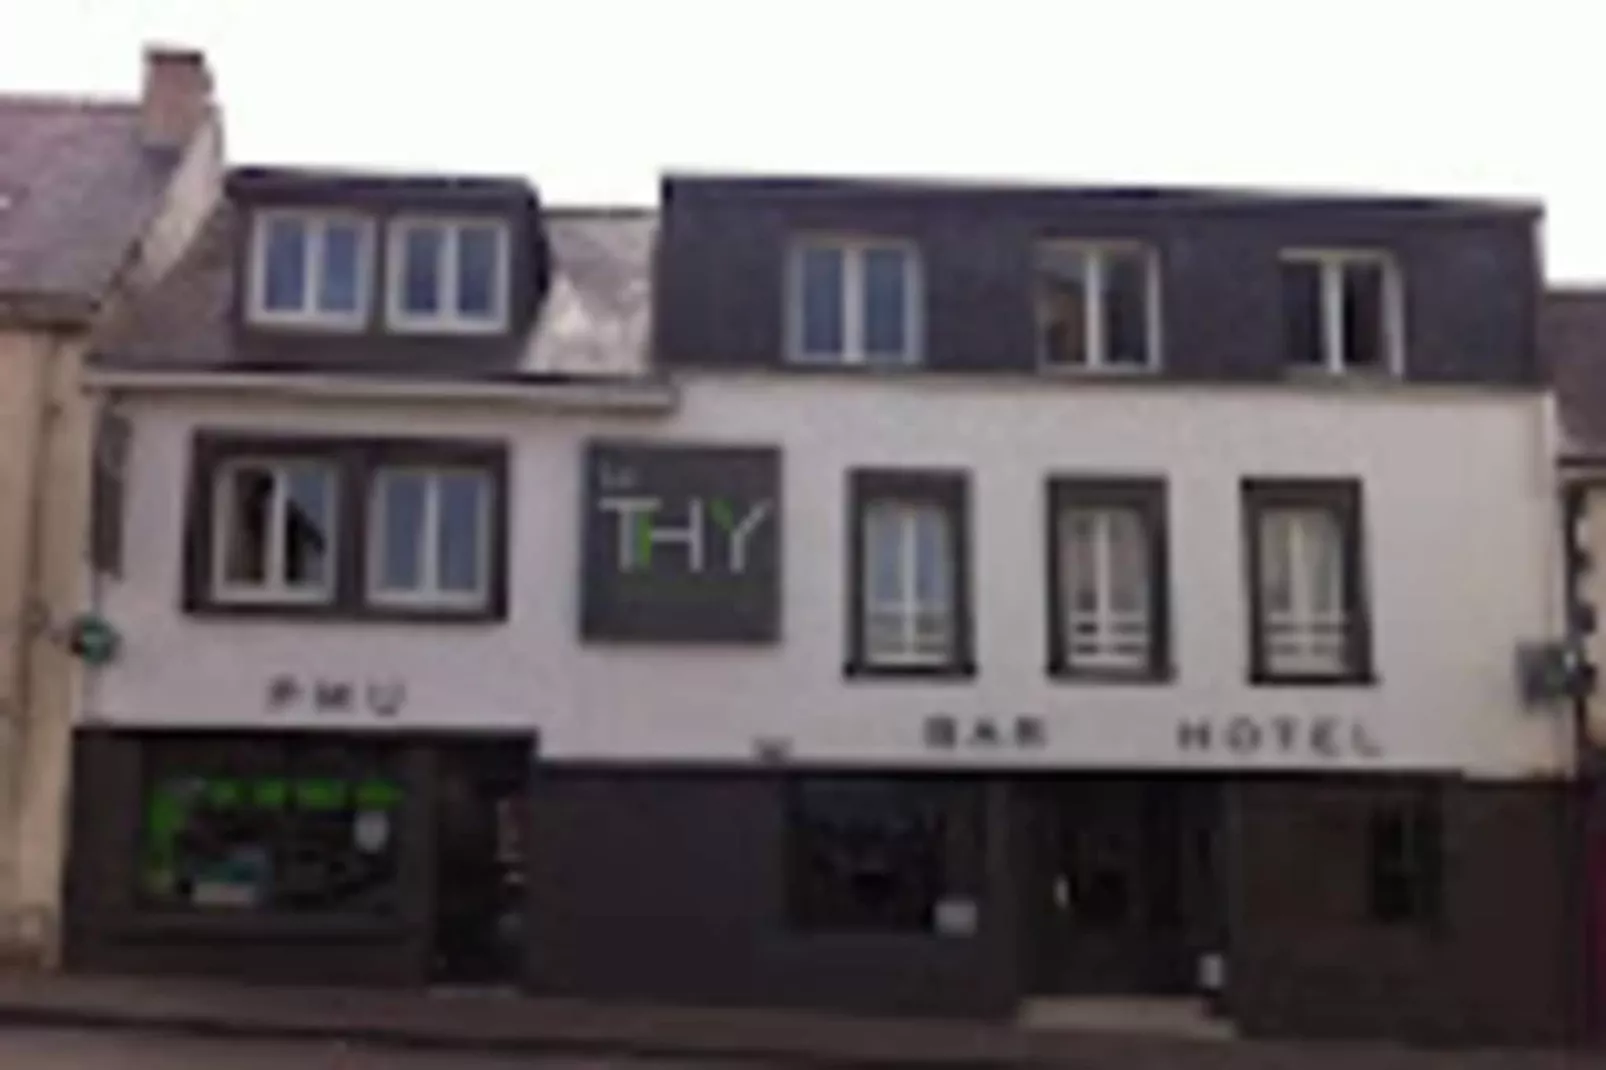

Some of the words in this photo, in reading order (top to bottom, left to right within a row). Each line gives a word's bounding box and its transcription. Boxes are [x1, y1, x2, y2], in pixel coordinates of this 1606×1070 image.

[598, 497, 769, 573] THY
[267, 676, 407, 718] PMU
[923, 715, 1048, 751] BAR
